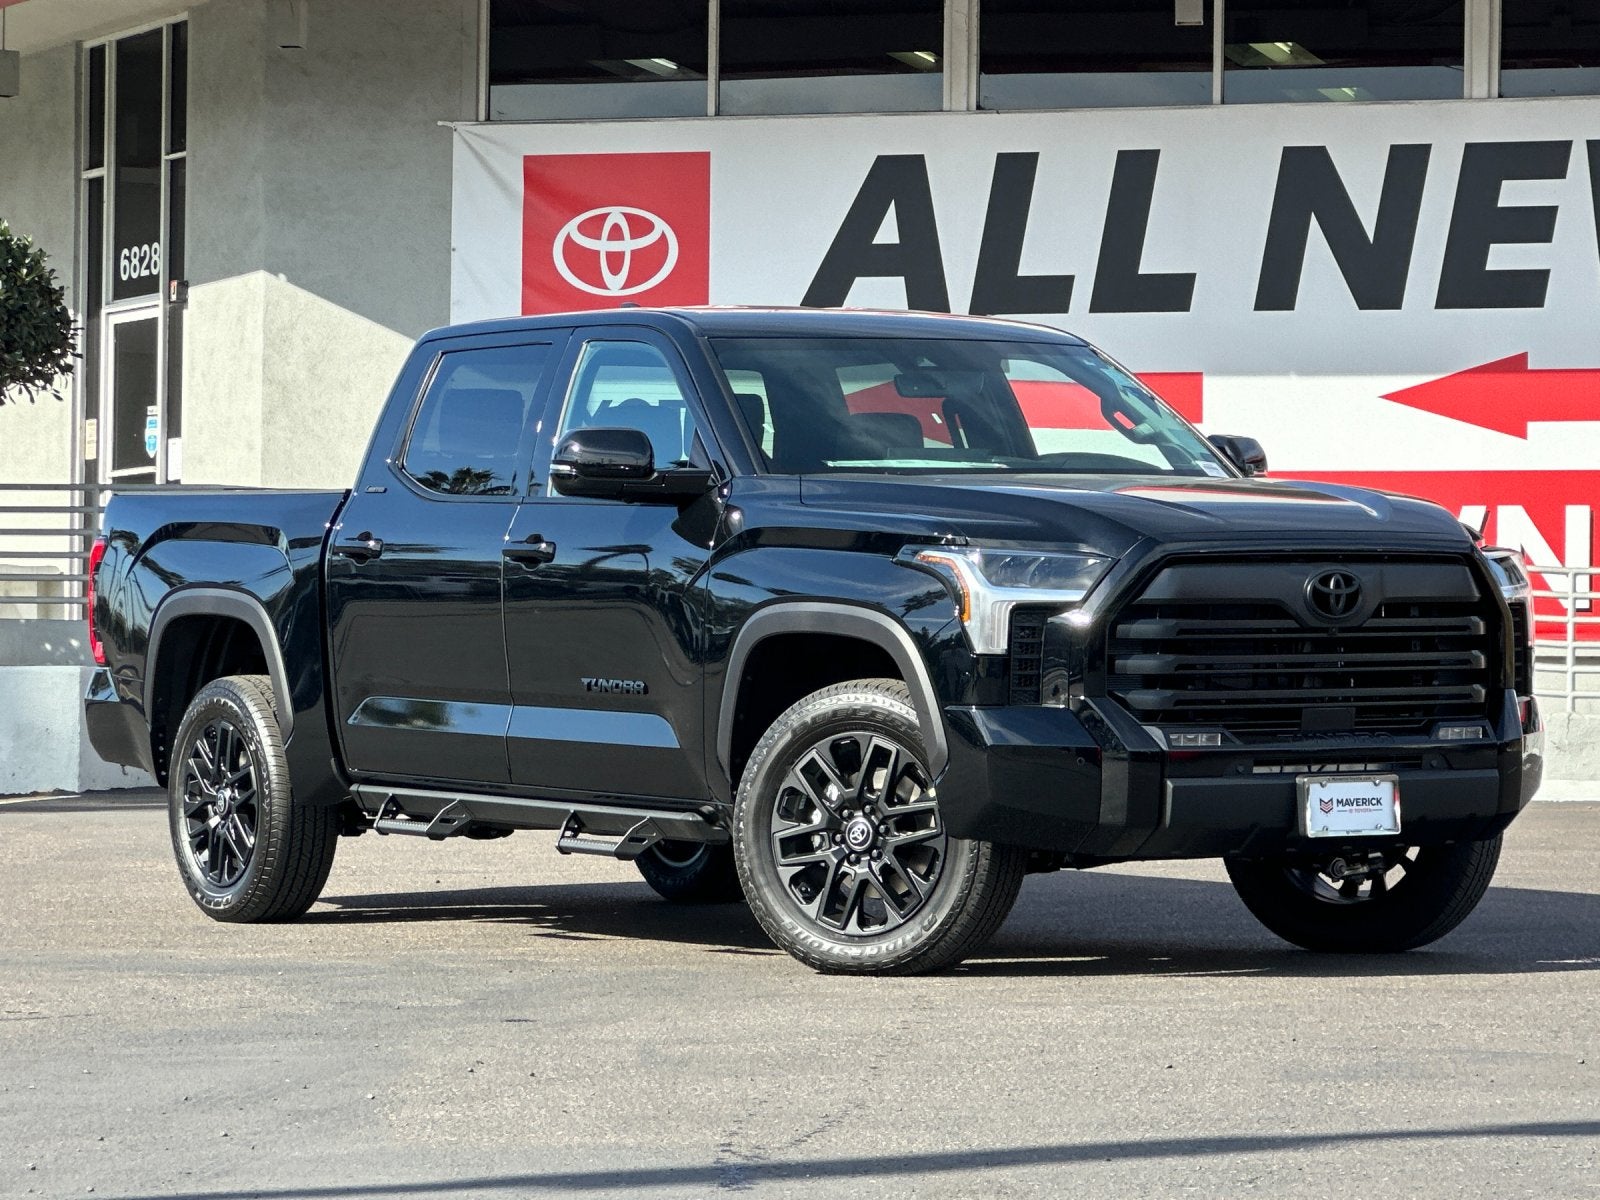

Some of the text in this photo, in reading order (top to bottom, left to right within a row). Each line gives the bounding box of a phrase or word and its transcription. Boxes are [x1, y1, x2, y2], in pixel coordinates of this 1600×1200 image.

[800, 139, 1600, 314] ALL NE
[120, 241, 160, 281] 6828
[580, 677, 649, 695] TUNDRA
[1336, 797, 1383, 808] MAVERICK
